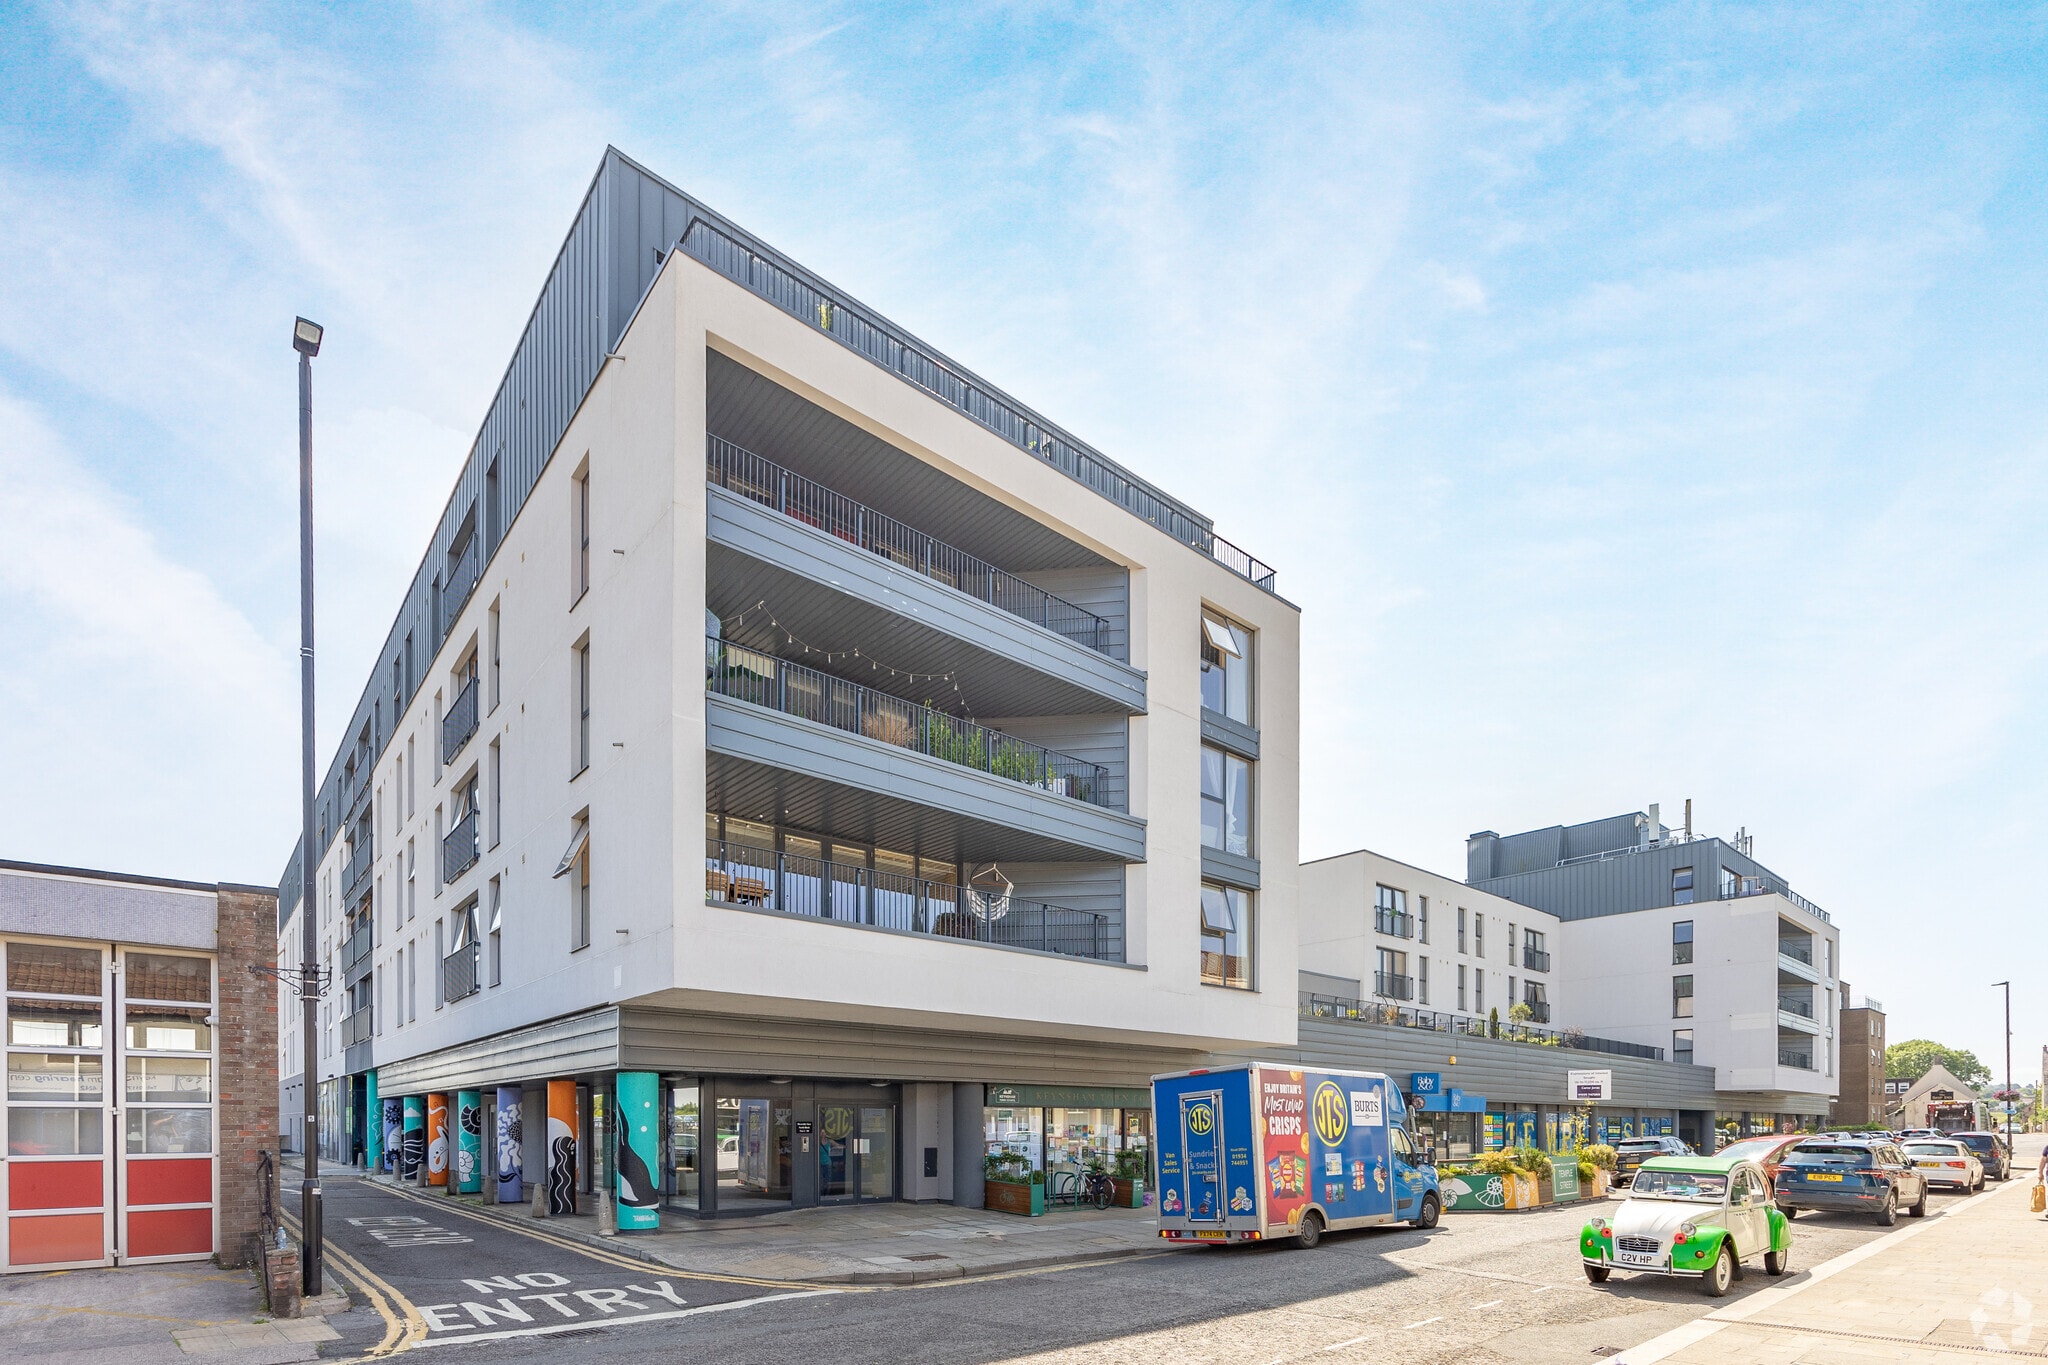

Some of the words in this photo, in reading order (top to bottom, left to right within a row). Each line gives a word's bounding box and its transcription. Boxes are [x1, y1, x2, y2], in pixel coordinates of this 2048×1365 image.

[1264, 1083, 1279, 1093] ENJOY
[1354, 1100, 1379, 1113] BURTS
[1317, 1089, 1345, 1139] JTS
[1269, 1116, 1302, 1135] CRISPS
[1189, 1150, 1215, 1158] Sundrie
[1558, 1169, 1573, 1178] TEMPLE
[1559, 1181, 1573, 1190] STREET
[1621, 1253, 1637, 1262] C2V
[1640, 1255, 1652, 1263] HP
[461, 1272, 571, 1294] NO
[416, 1280, 688, 1332] ENTRY
